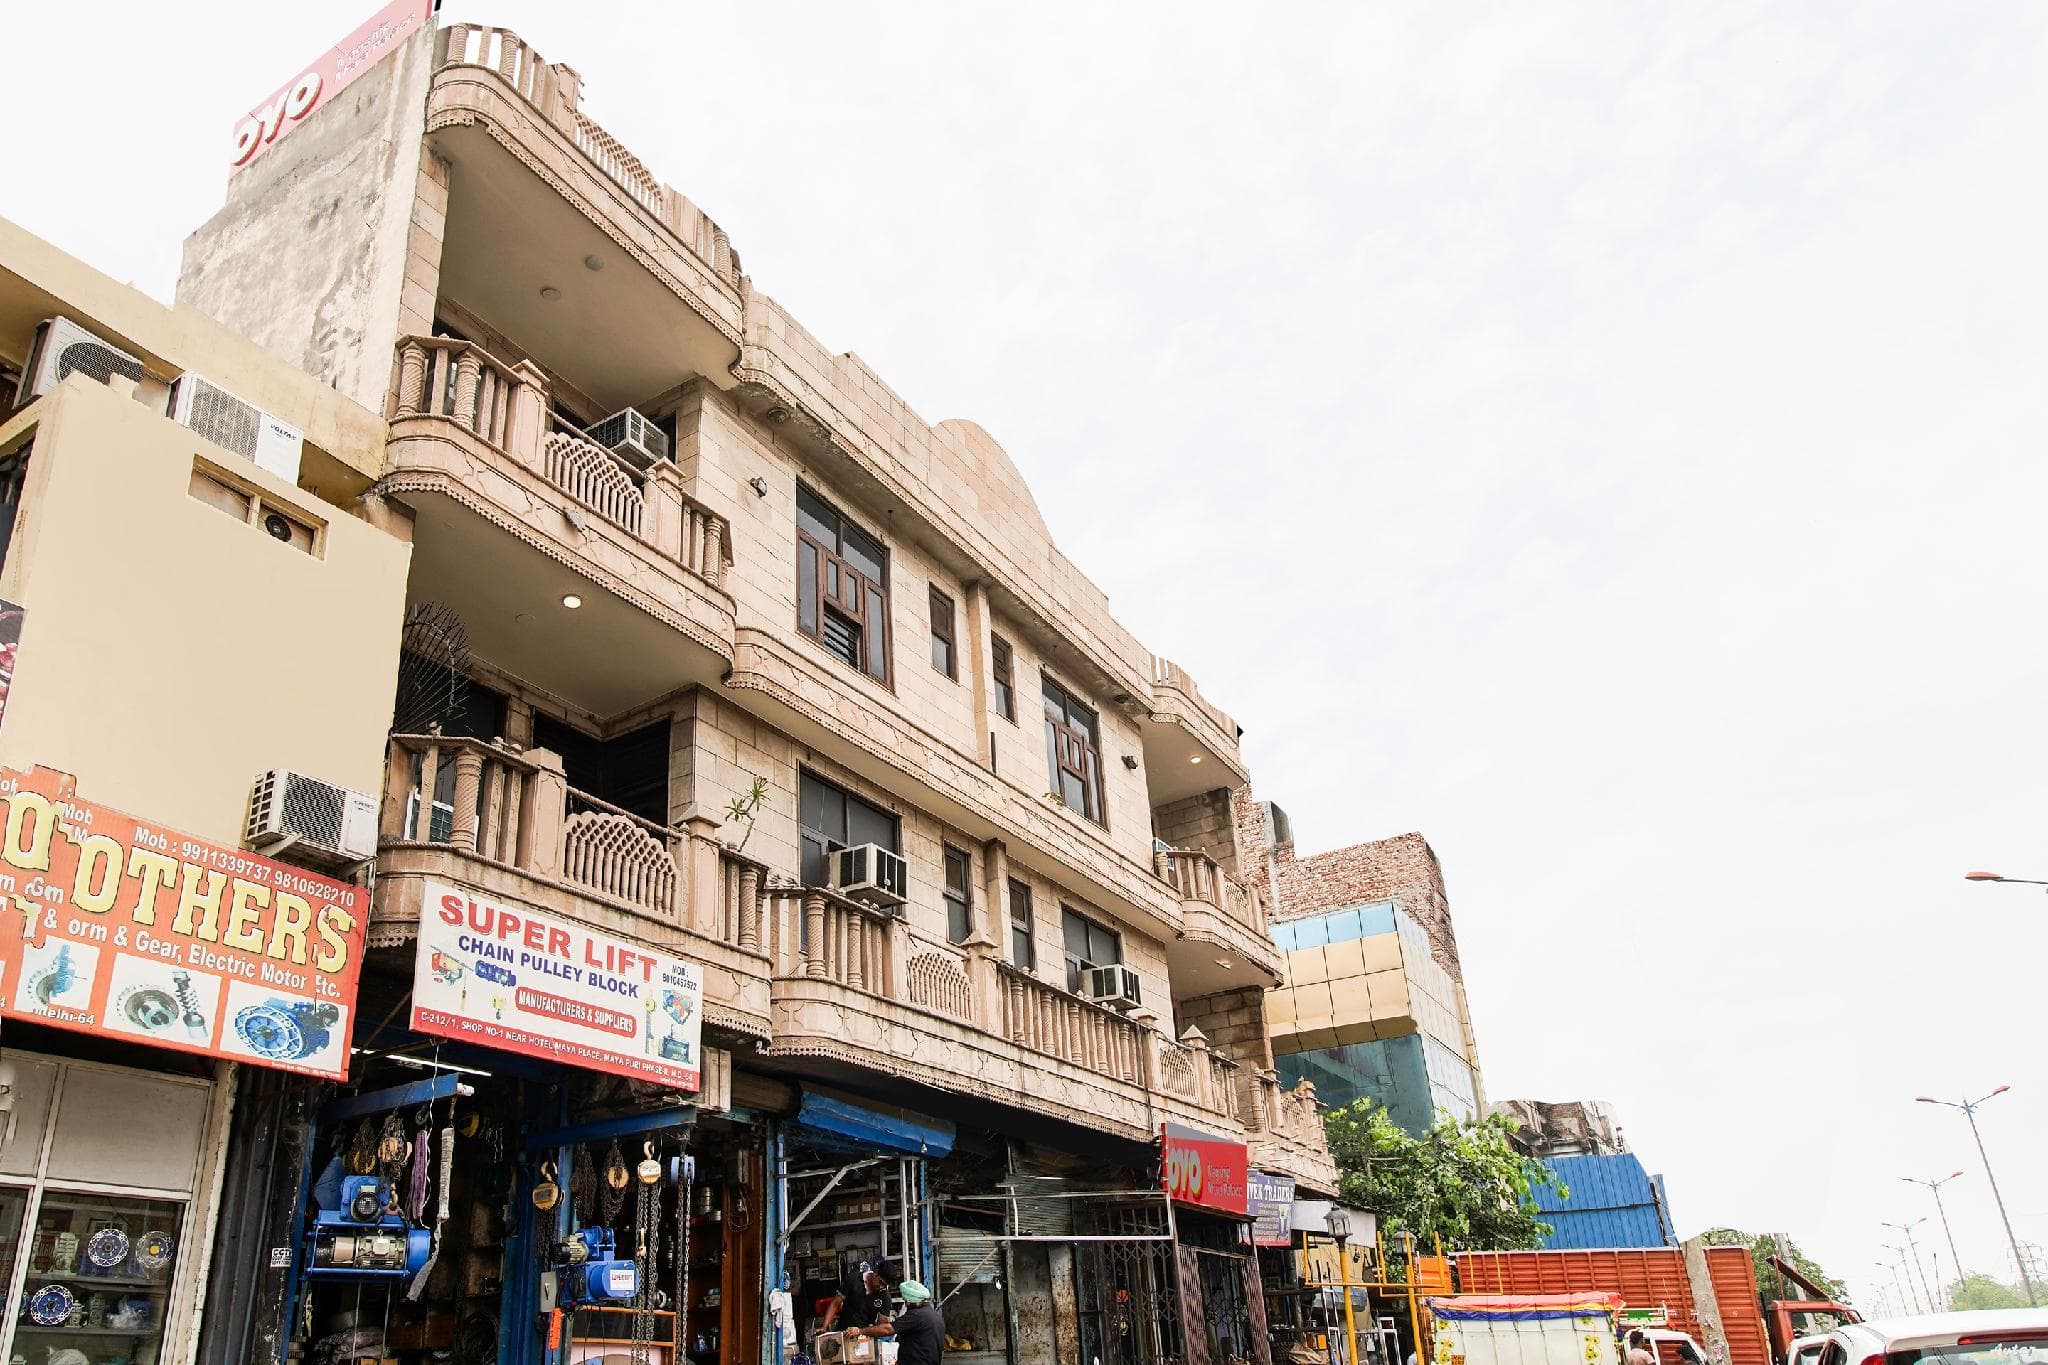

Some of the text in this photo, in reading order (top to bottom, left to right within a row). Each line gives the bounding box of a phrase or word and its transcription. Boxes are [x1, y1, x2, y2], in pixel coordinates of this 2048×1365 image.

[231, 72, 322, 166] OYO
[134, 826, 168, 850] Mob
[67, 918, 107, 942] orm
[114, 926, 129, 949] &
[135, 930, 183, 965] Gear,
[188, 944, 256, 978] Electric
[260, 962, 308, 990] Motor
[438, 894, 657, 982] SUPER LIFT
[458, 935, 639, 998] CHAIN PULLEY BLOCK
[461, 1021, 483, 1032] SHOP
[505, 1031, 527, 1043] NEAR
[528, 1037, 553, 1049] HOTEL
[518, 990, 586, 1020] MANUFACTURERS
[595, 1012, 633, 1033] SUPPLIERS
[1168, 1147, 1203, 1197] OYO
